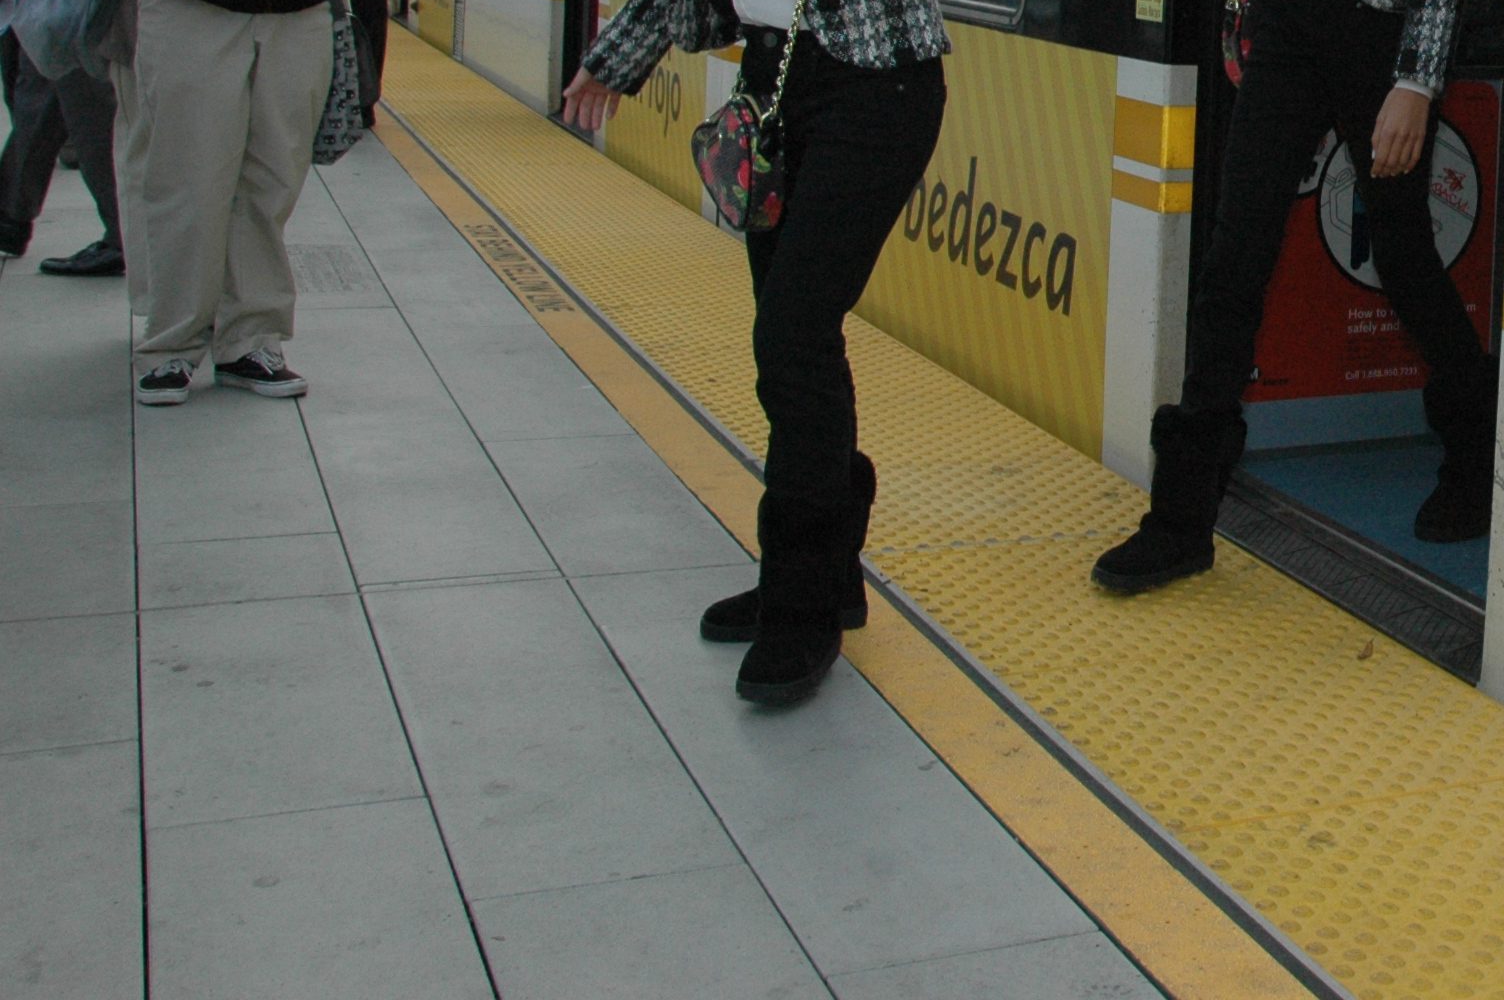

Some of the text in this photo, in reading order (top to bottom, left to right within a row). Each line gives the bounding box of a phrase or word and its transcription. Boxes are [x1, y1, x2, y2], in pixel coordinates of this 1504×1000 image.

[903, 155, 1077, 317] bedezca
[1347, 307, 1373, 319] How
[1375, 308, 1387, 319] to
[1347, 319, 1400, 335] safely and
